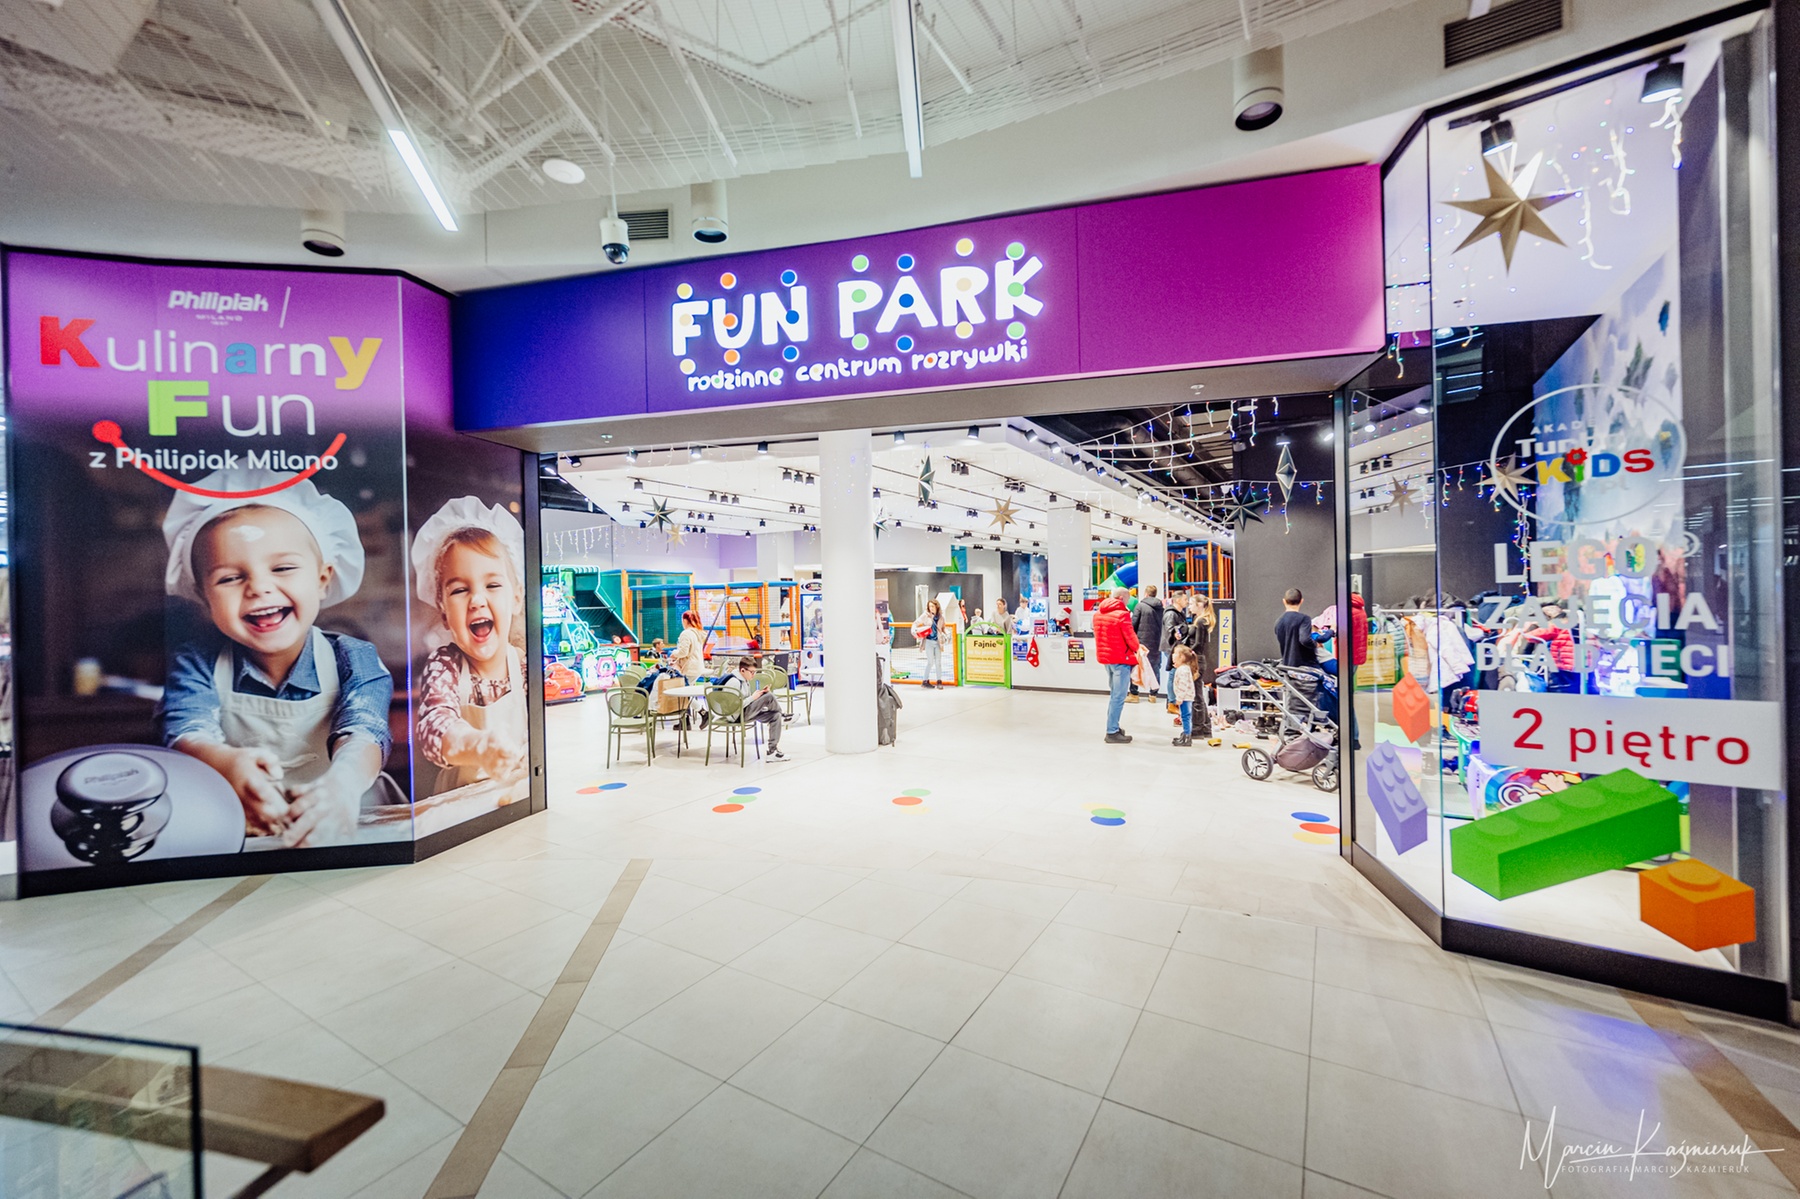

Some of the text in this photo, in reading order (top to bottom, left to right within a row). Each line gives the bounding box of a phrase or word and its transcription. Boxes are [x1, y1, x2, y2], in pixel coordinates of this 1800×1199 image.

[168, 290, 269, 314] Philipiak
[672, 256, 1044, 357] FUN PARK
[39, 316, 383, 390] Kulinarny
[687, 339, 1029, 393] rodzinne centrum rozrywki
[147, 380, 317, 437] Fun
[88, 447, 339, 475] z Philipiak Milano
[973, 640, 997, 649] Fajnie
[1477, 643, 1558, 673] DLA
[1513, 708, 1750, 768] 2 piętro
